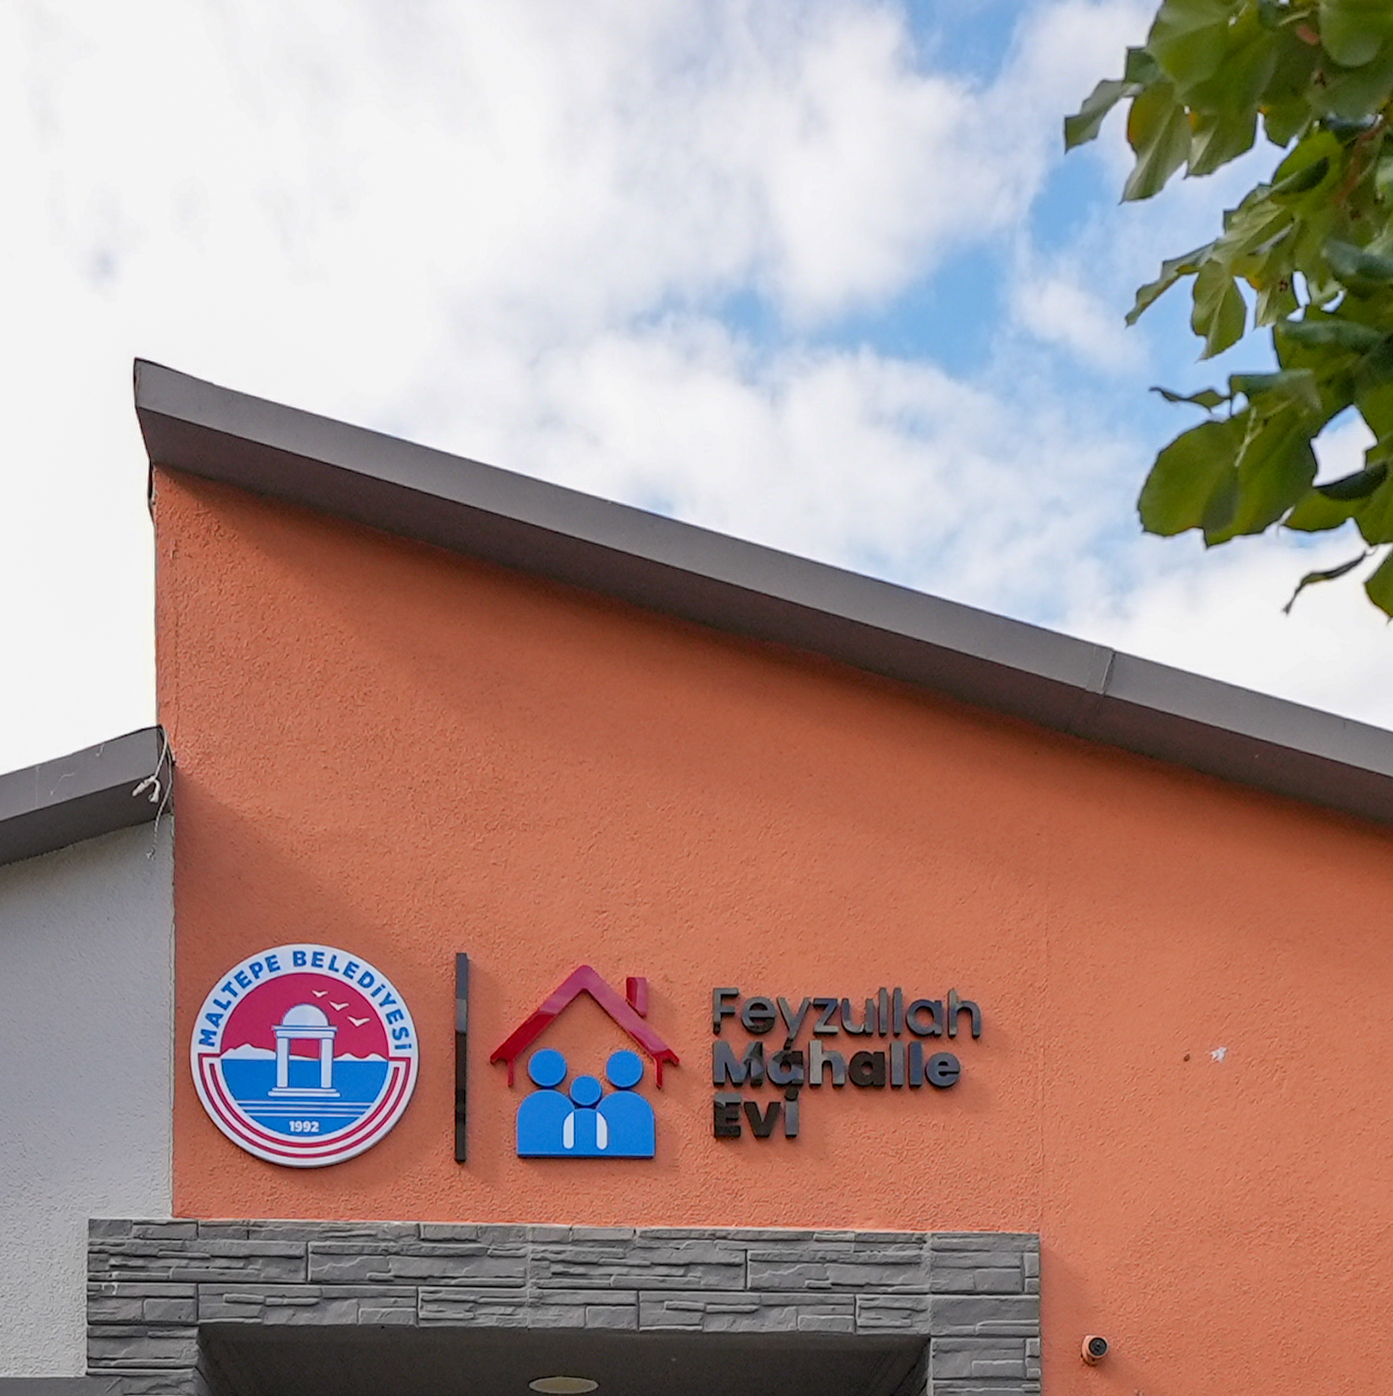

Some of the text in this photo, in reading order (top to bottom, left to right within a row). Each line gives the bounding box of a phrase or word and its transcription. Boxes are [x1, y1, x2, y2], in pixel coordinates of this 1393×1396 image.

[198, 950, 412, 1051] MALTEPE BELEDİYESİ
[712, 986, 982, 1050] Feyzullah
[711, 1039, 962, 1089] Mahalle
[289, 1120, 320, 1133] 1992
[712, 1087, 800, 1138] Evi
